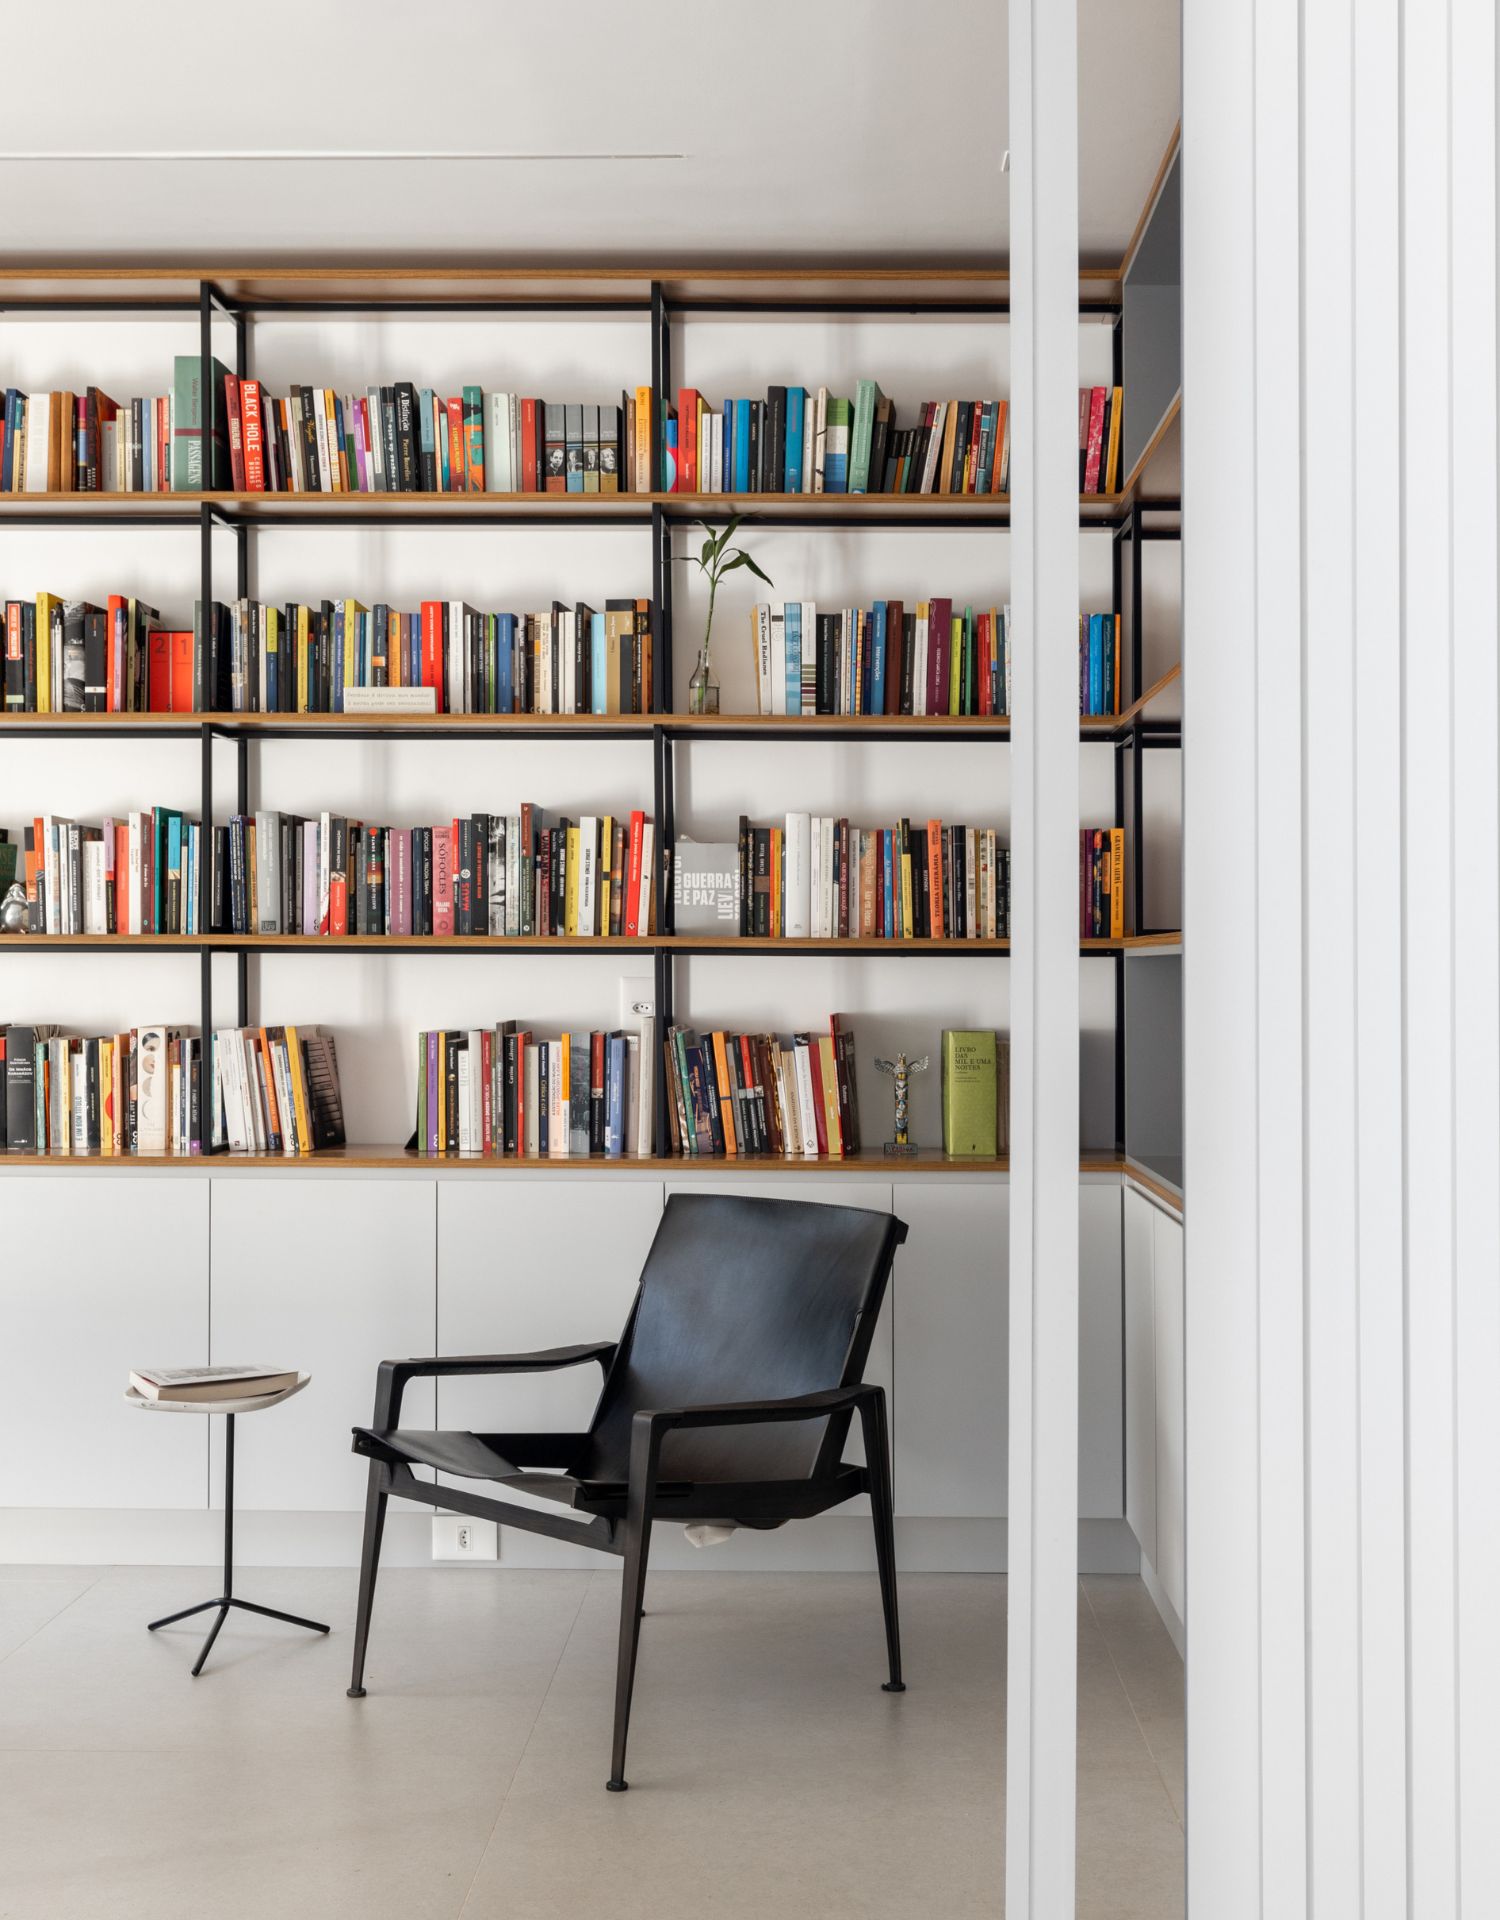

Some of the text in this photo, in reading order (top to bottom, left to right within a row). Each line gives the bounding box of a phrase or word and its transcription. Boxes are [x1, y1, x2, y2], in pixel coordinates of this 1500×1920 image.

[244, 384, 259, 452] BLACK HOLE
[401, 399, 410, 431] Distinção
[188, 440, 201, 484] PASSAGENS
[438, 843, 446, 894] SÓFOCLES
[683, 872, 732, 889] GUERRA
[461, 883, 469, 911] MAUS
[683, 890, 716, 906] E PAZ
[718, 893, 734, 920] LIEV
[75, 1128, 82, 1136] UM
